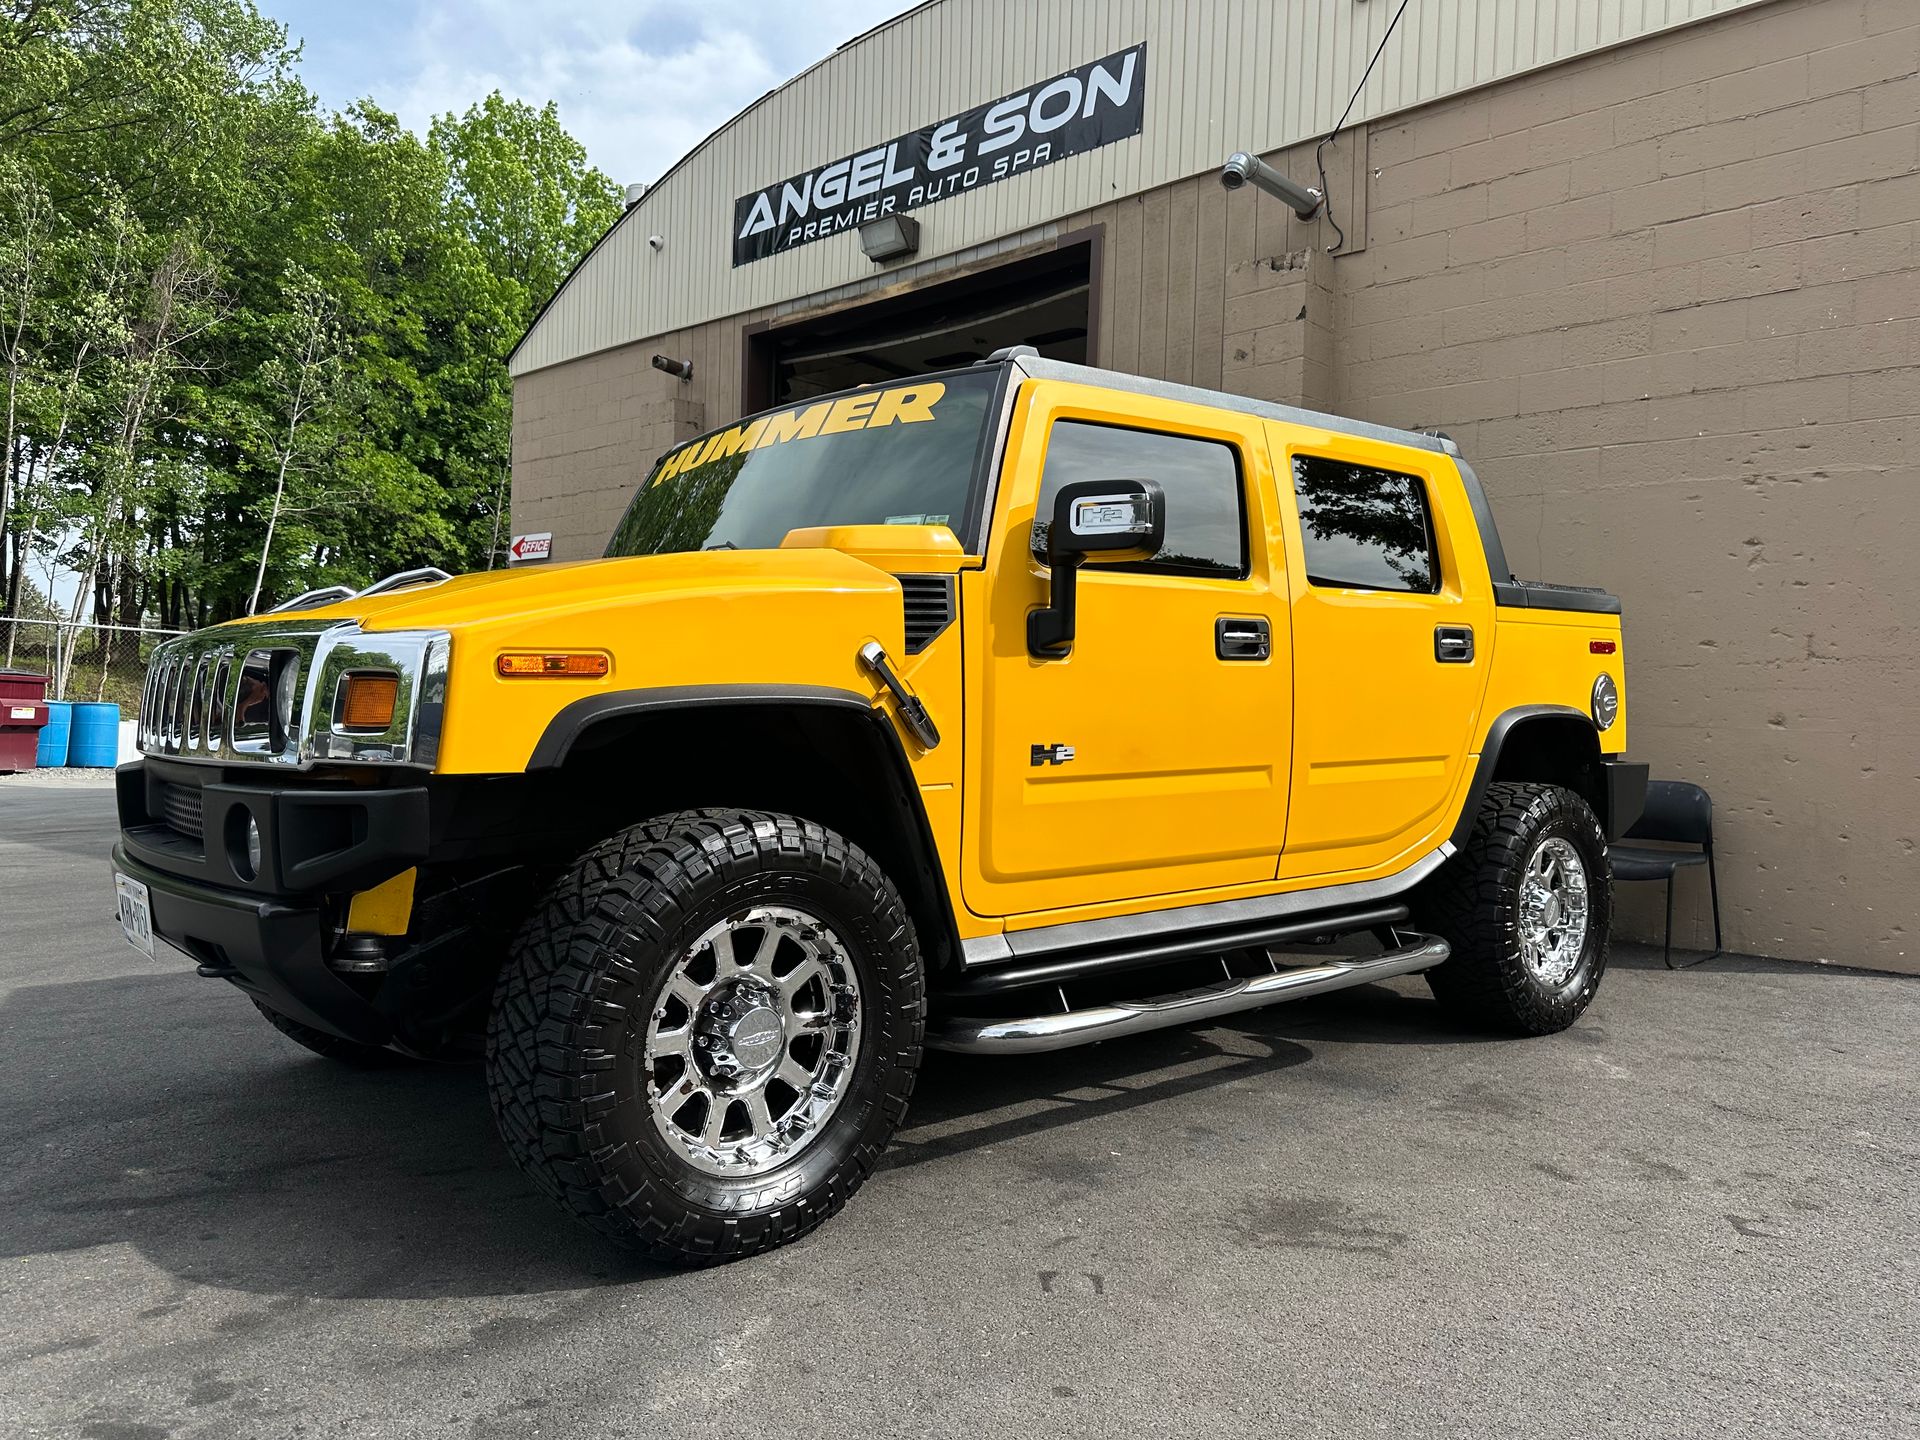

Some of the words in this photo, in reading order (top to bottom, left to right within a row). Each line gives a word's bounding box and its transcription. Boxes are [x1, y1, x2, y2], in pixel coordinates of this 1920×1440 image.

[738, 143, 915, 239] ANGEL
[927, 120, 969, 173] &
[977, 52, 1137, 156] SON
[788, 197, 896, 246] PREMIER
[907, 167, 980, 206] AUTO
[992, 142, 1053, 178] SPA
[652, 382, 946, 488] HUMMER
[520, 540, 550, 553] OFFICE
[1031, 744, 1075, 766] H2
